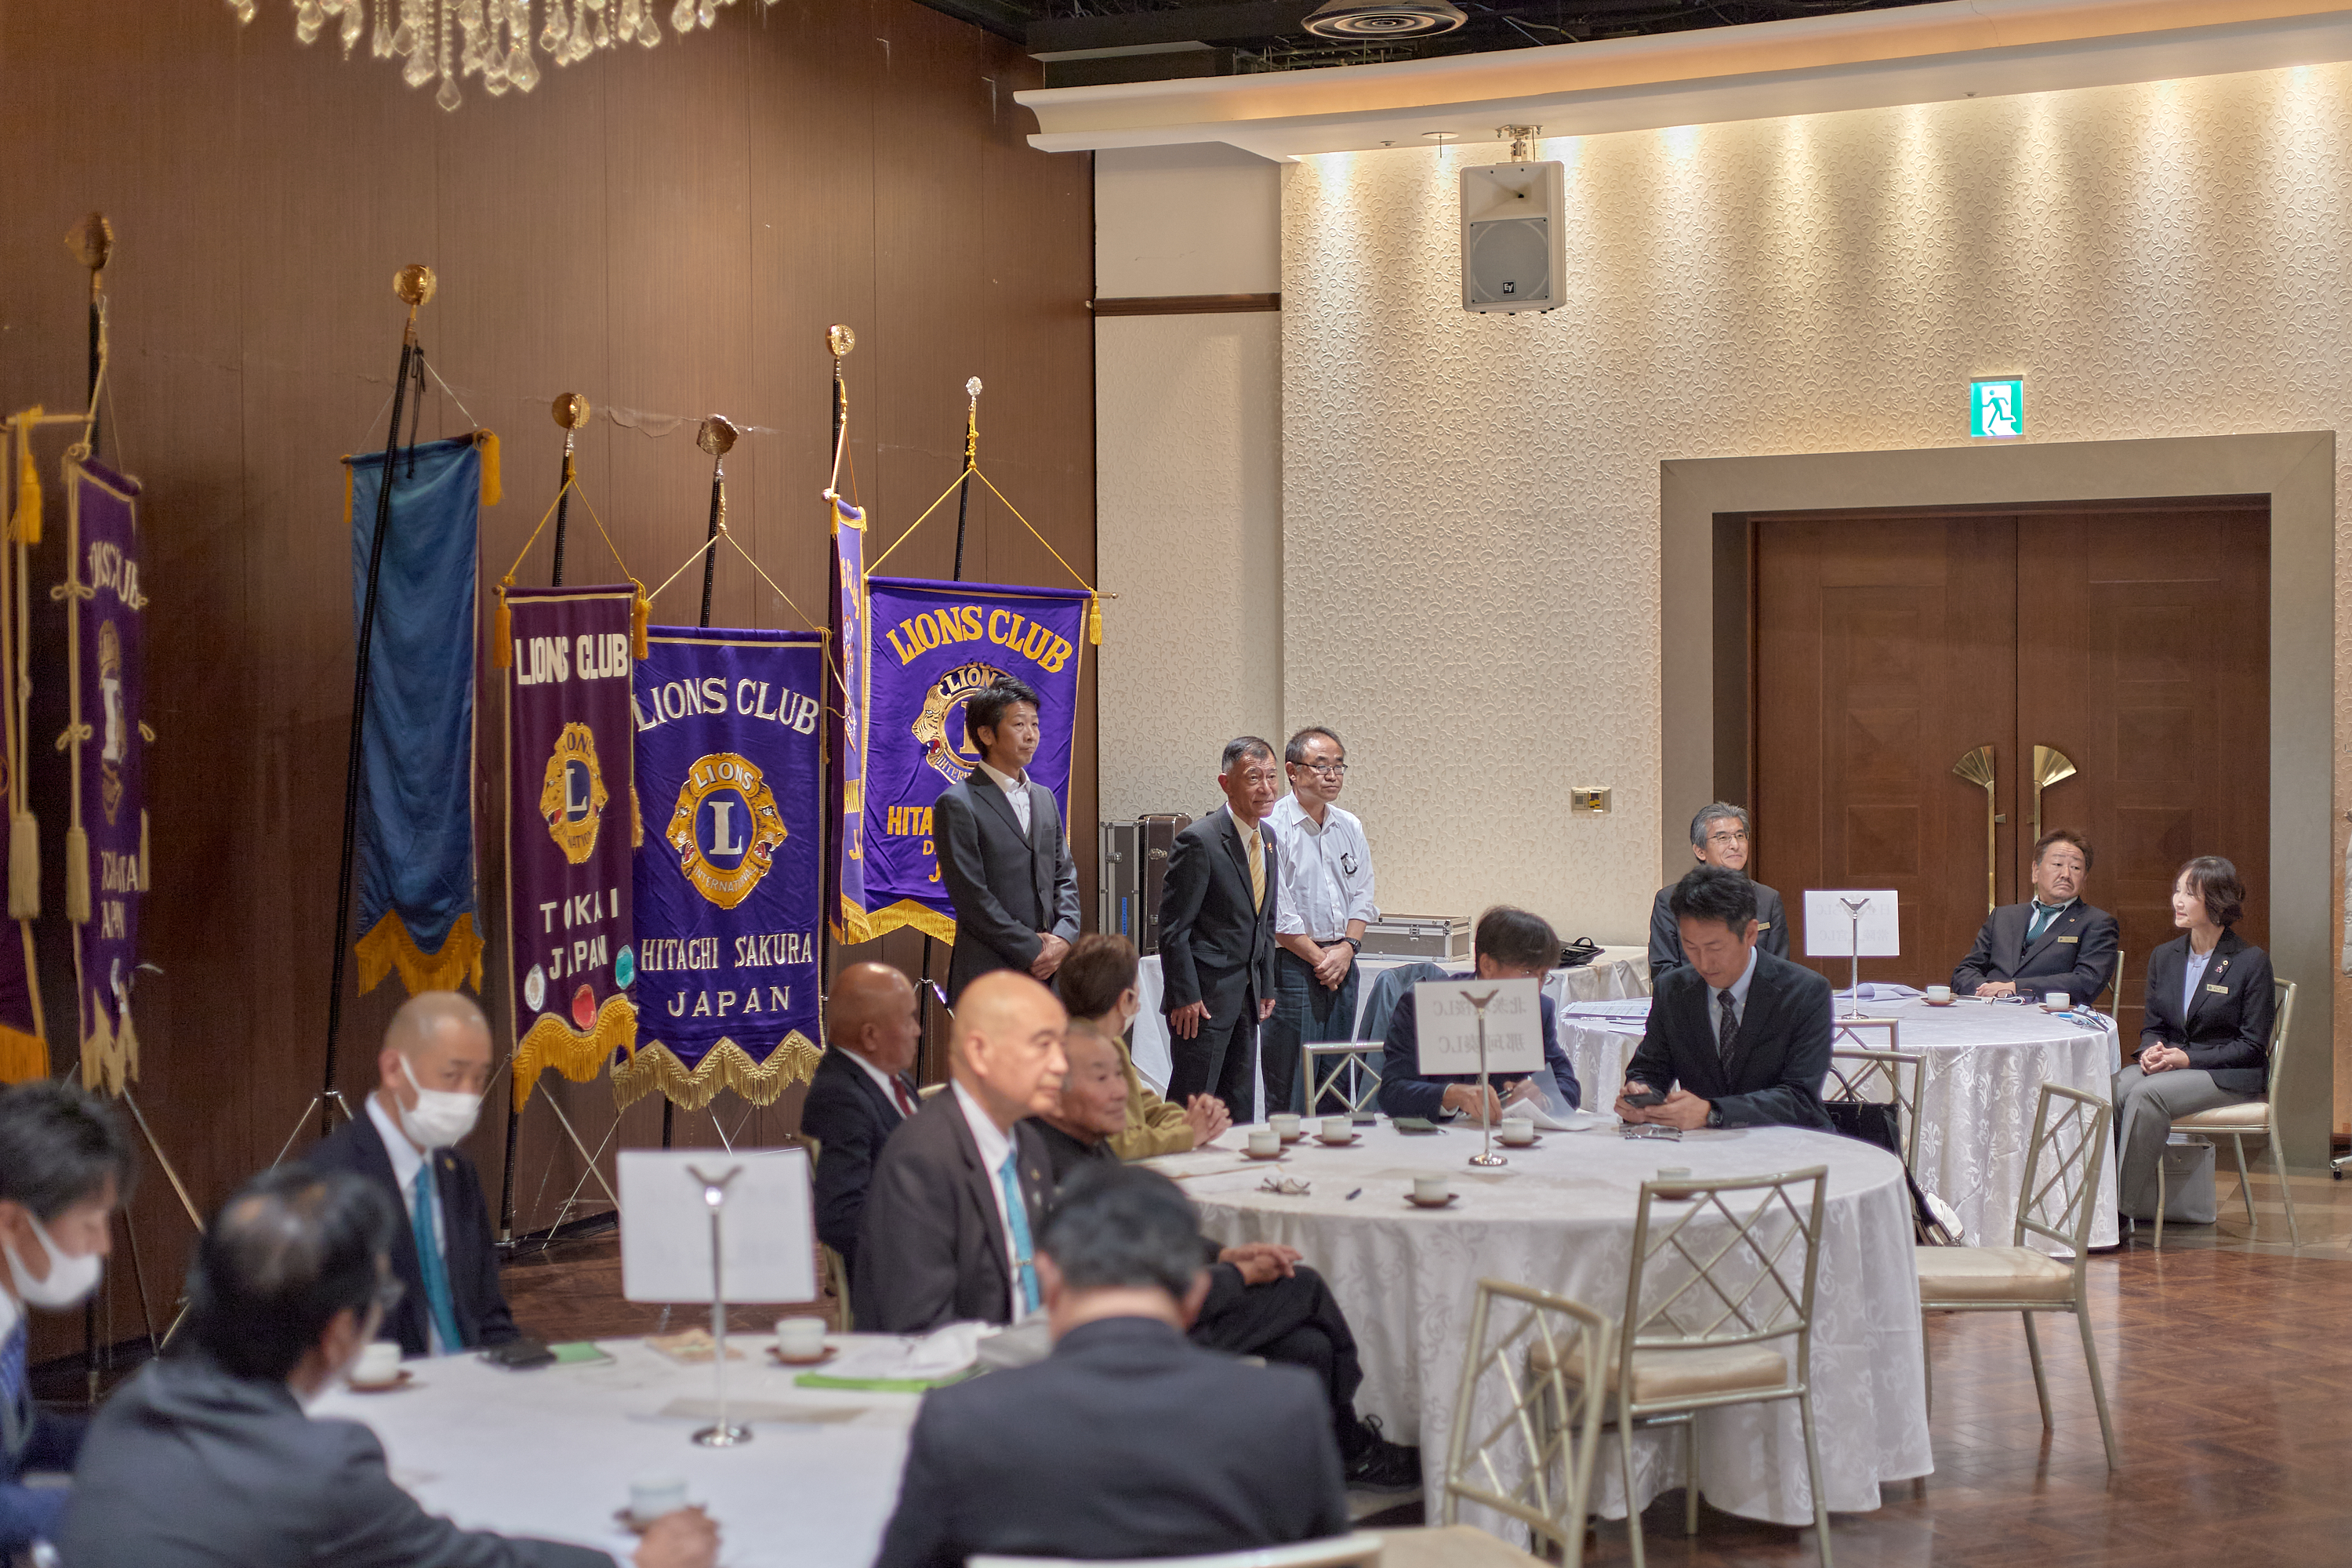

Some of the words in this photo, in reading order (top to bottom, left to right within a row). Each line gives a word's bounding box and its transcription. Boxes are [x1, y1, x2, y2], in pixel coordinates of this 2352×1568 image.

[1504, 283, 1514, 292] EV
[885, 605, 983, 666] LIONS
[988, 608, 1073, 673] CLUB
[515, 636, 569, 684] LIONS
[576, 633, 628, 680] CLUB
[944, 667, 998, 693] LION
[632, 677, 728, 731] LIONS
[736, 678, 819, 735] CLUB
[563, 731, 593, 758] ONS
[565, 768, 588, 812] L
[695, 762, 754, 790] LIONS
[708, 801, 742, 855] L
[887, 806, 934, 836] HITA
[693, 865, 757, 893] INTERNATIONAL
[539, 887, 619, 934] TOKAI
[641, 937, 719, 971] HITACHI
[735, 933, 813, 967] SAKURA
[668, 985, 790, 1017] JAPAN
